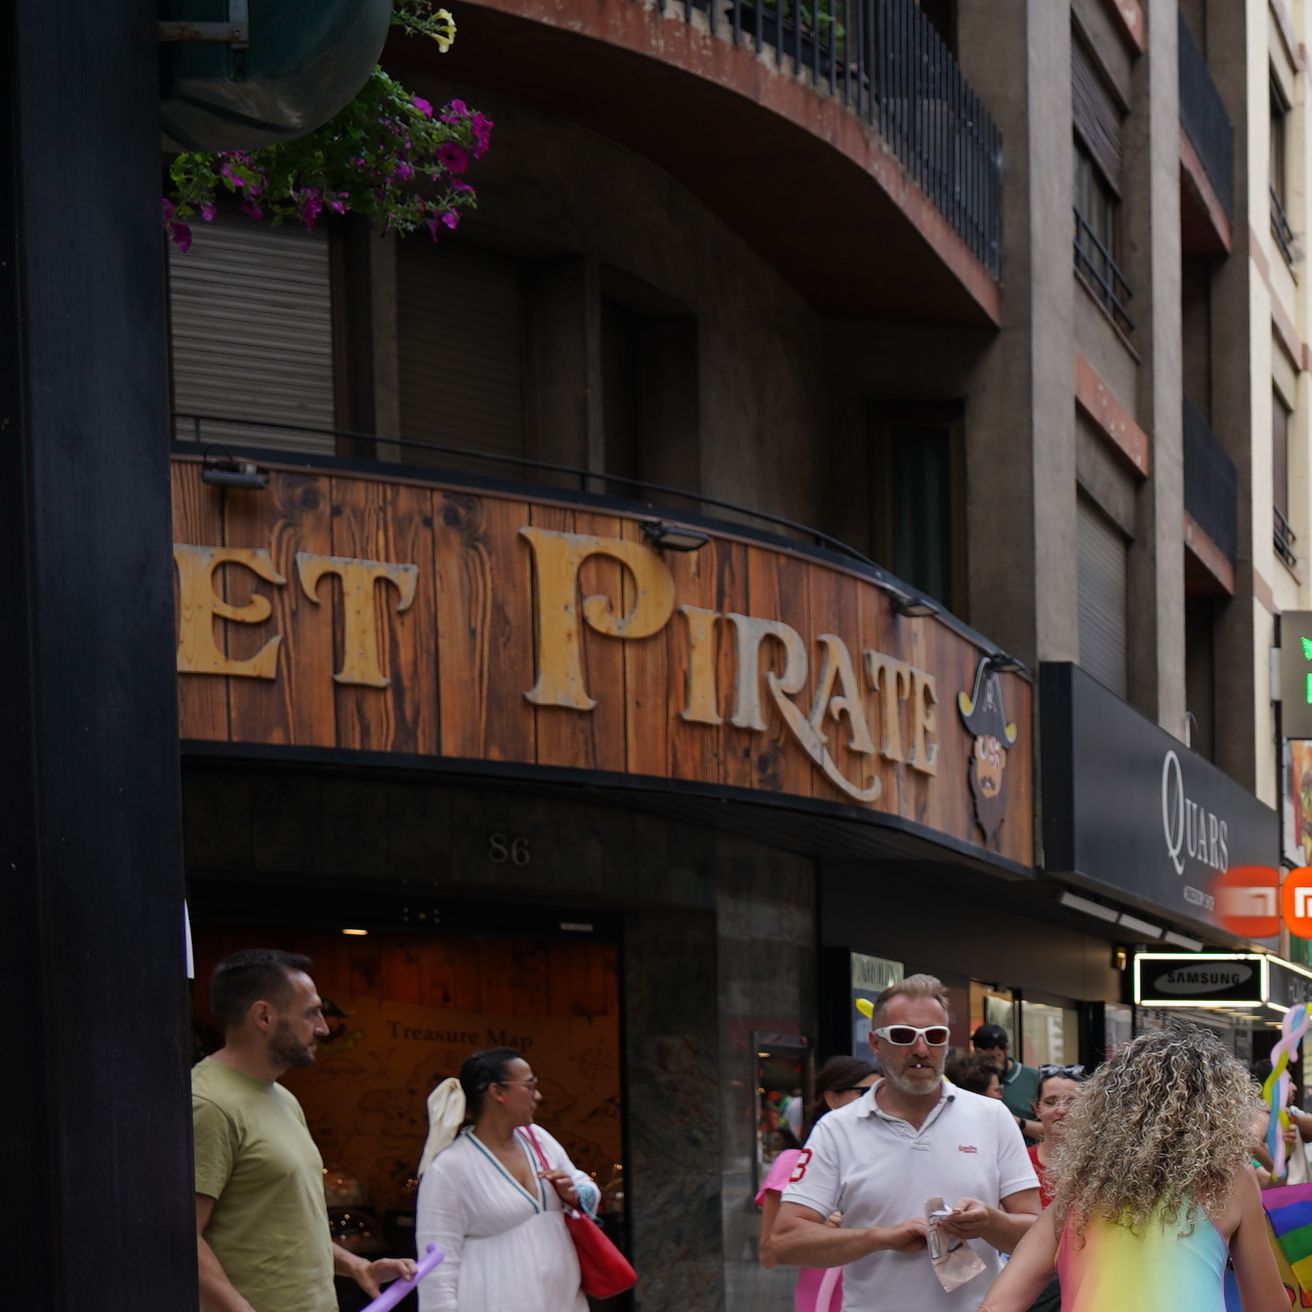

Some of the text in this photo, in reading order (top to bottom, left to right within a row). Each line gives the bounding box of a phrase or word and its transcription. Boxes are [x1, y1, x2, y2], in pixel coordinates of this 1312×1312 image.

[518, 525, 939, 802] PIRATE
[1162, 750, 1229, 876] QUARS
[490, 832, 531, 867] 86
[1167, 969, 1240, 985] SAMSUNG
[386, 1020, 534, 1053] Treasure Map
